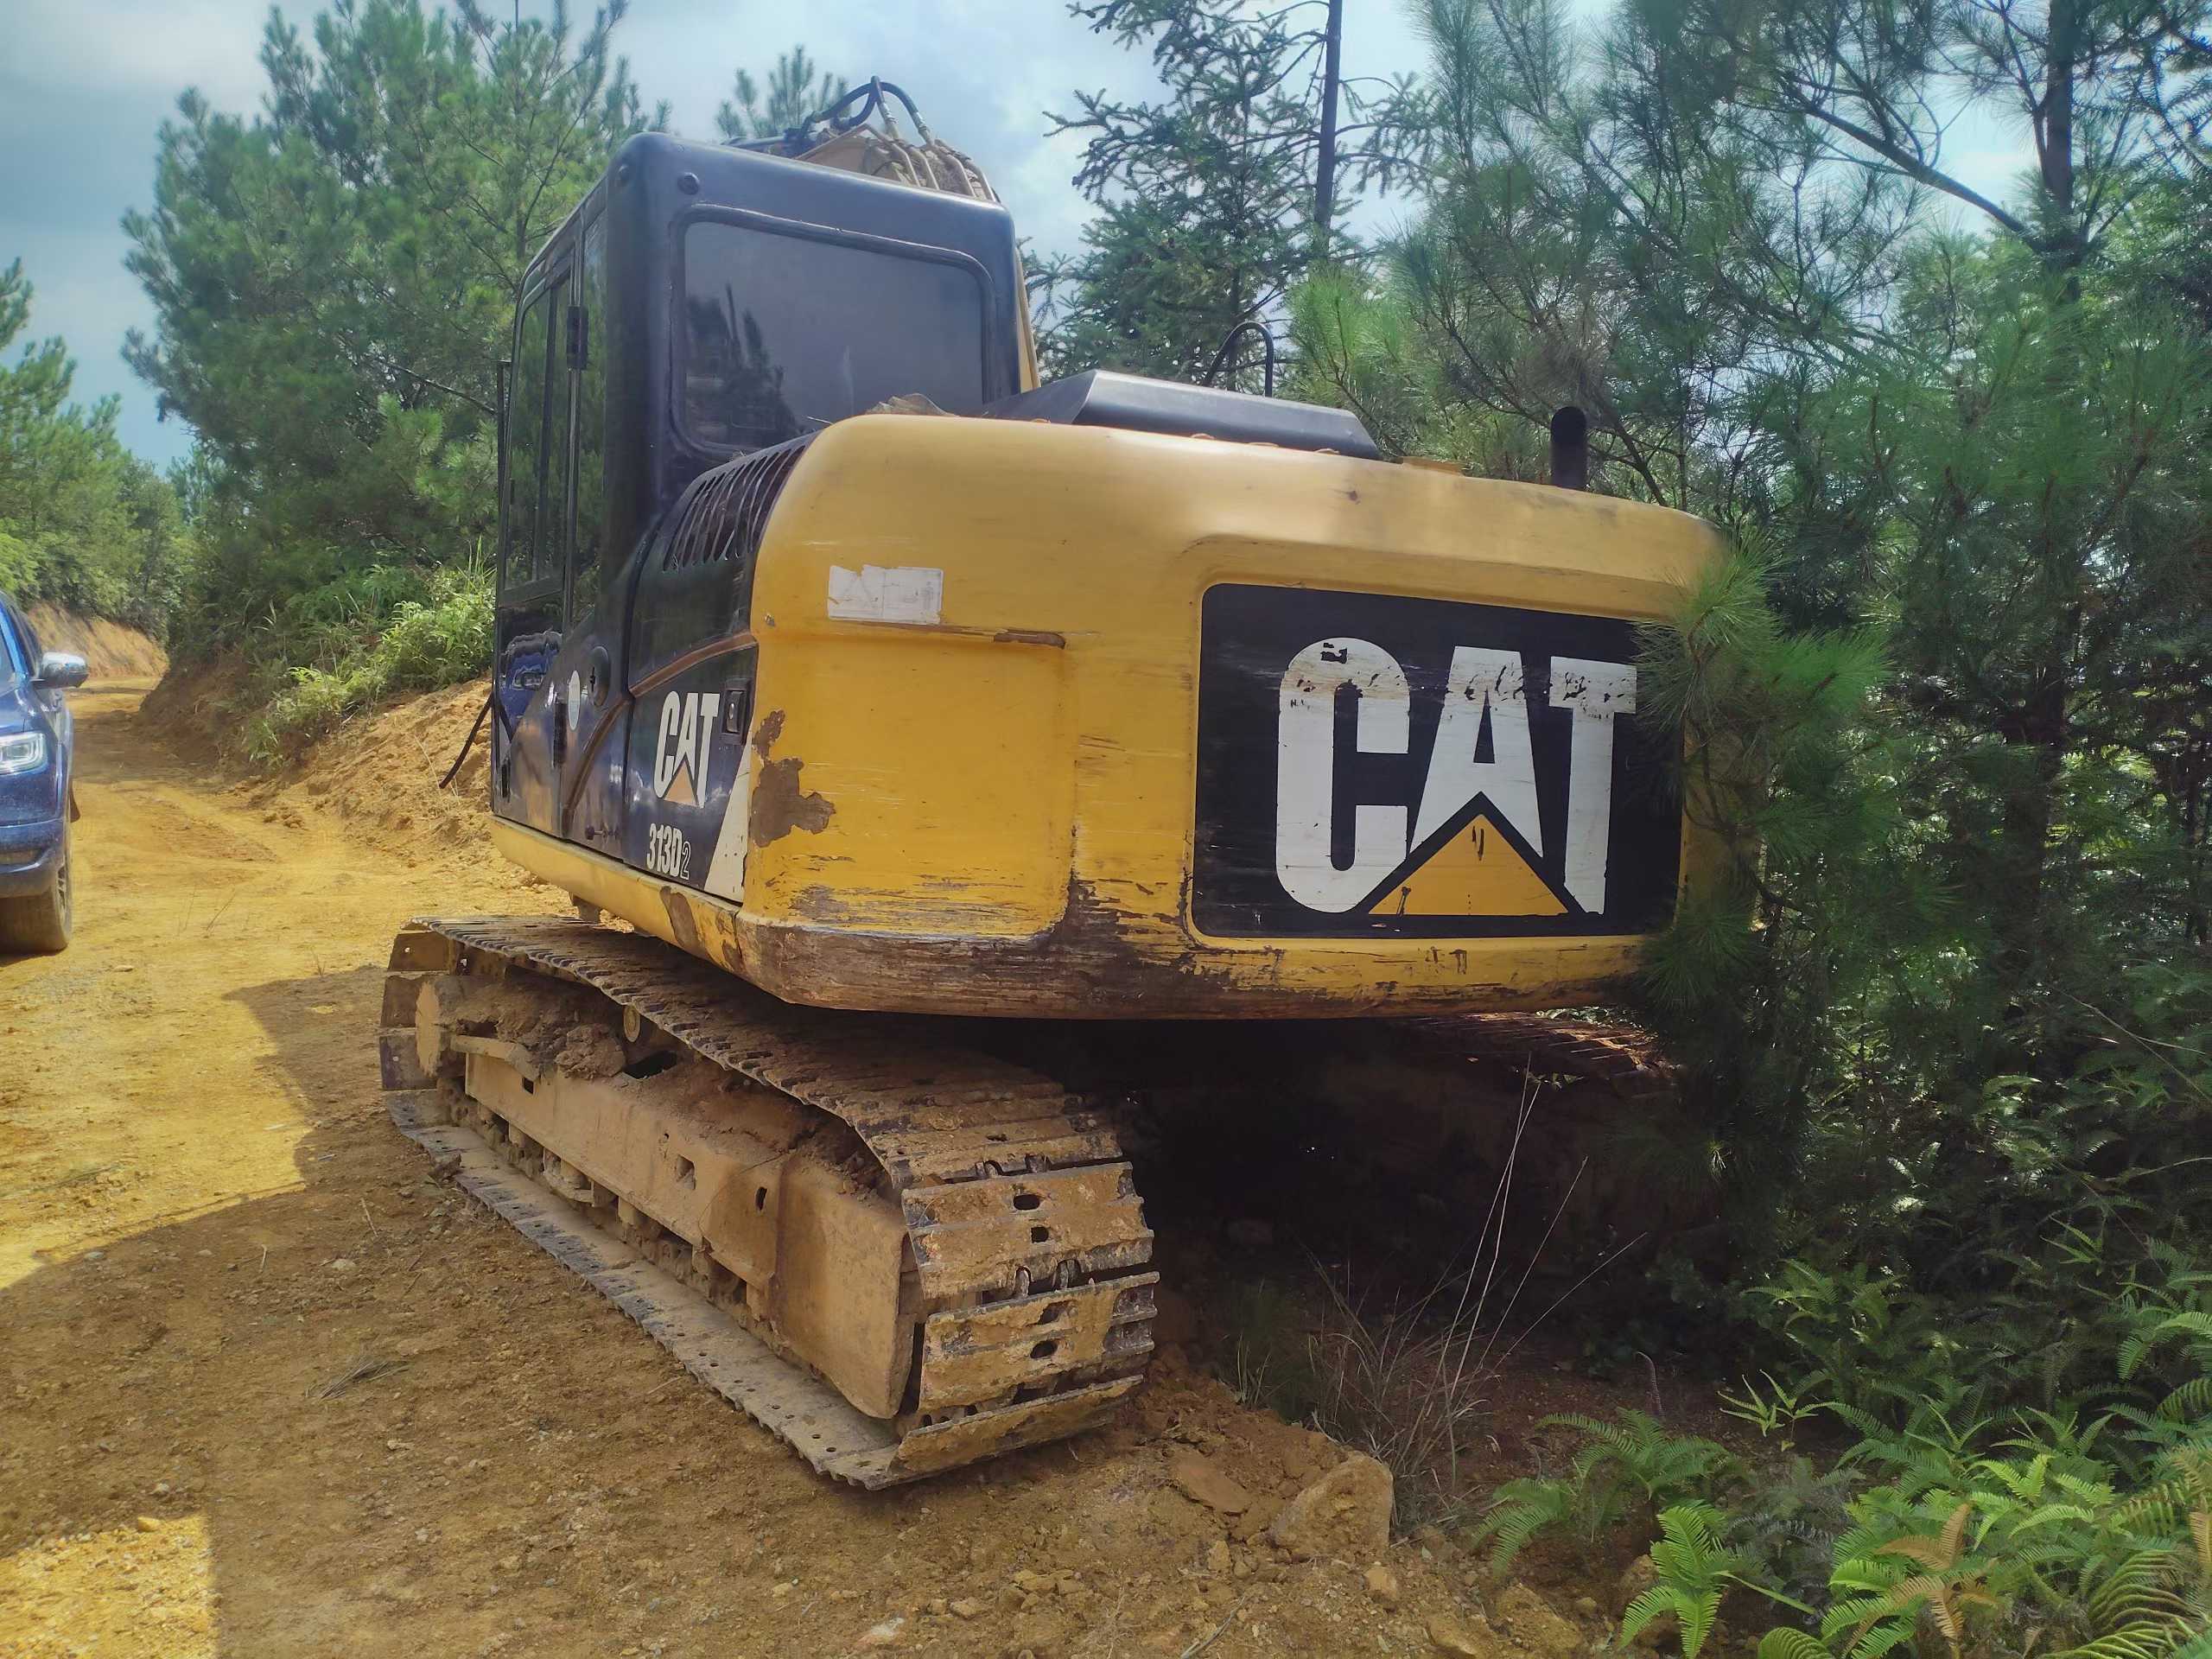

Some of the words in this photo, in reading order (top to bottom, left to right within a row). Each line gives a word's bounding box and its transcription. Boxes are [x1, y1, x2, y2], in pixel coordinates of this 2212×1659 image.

[654, 691, 720, 808] CAT
[1275, 637, 1637, 914] CAT
[647, 823, 690, 880] 313D2
